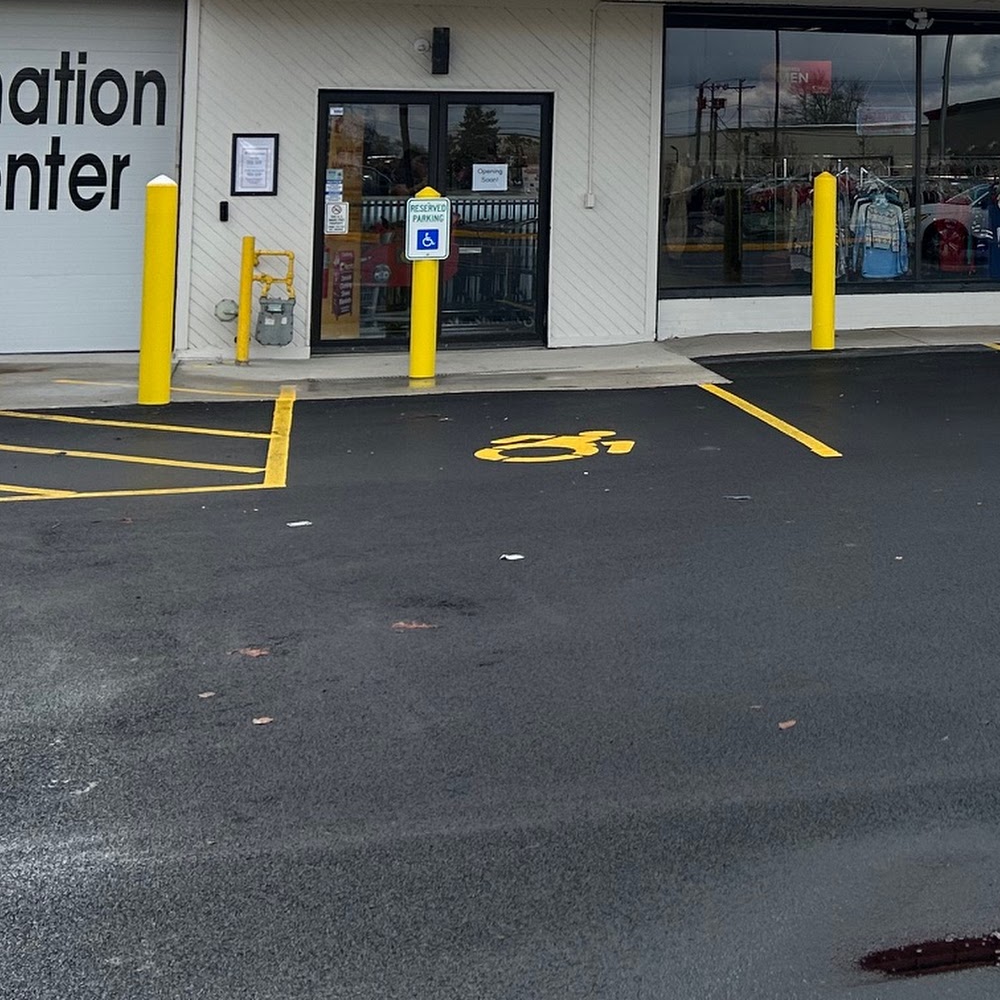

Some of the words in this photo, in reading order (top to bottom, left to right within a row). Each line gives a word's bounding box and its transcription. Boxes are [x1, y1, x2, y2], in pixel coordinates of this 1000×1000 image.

[0, 50, 167, 126] ation
[0, 136, 131, 212] nter
[411, 204, 446, 213] RESERVED
